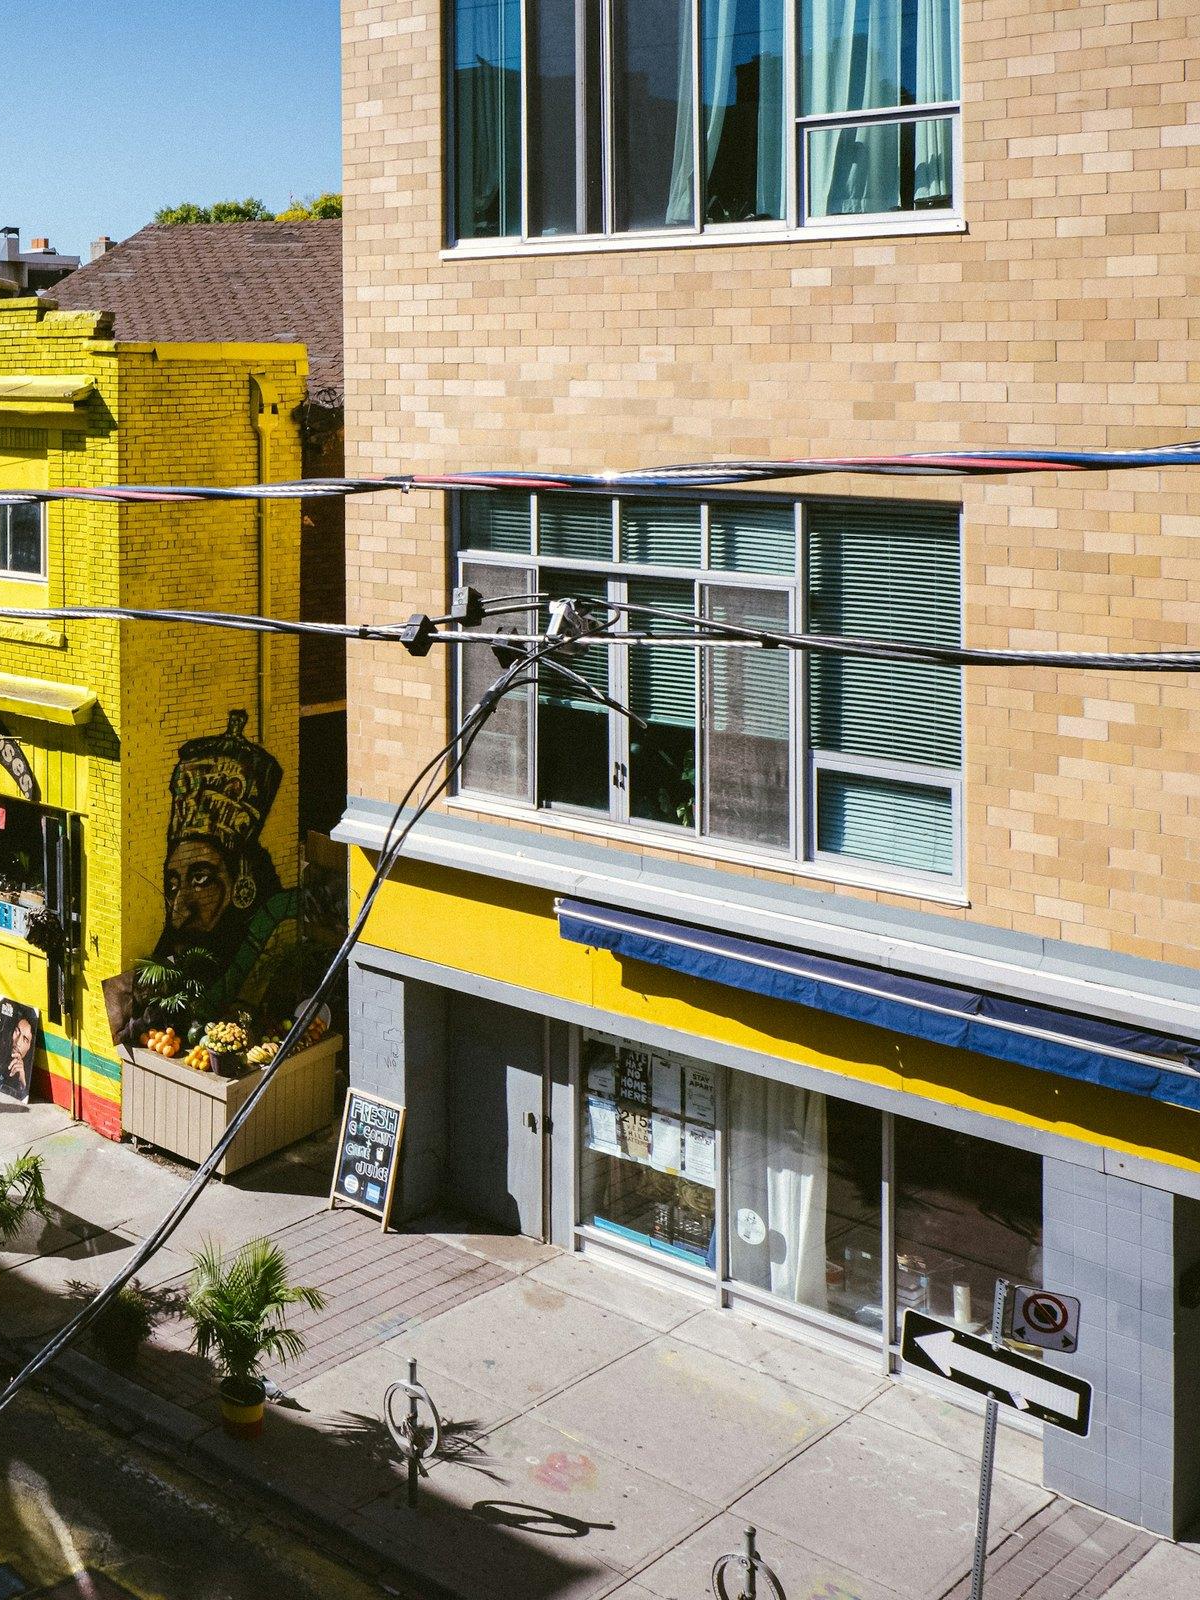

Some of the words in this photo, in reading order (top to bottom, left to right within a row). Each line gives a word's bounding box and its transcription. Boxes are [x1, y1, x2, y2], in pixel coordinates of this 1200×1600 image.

[626, 1059, 643, 1072] HAS
[627, 1068, 641, 1080] NO
[621, 1076, 647, 1093] HOME
[689, 1080, 714, 1092] APART
[692, 1072, 710, 1084] STAY
[620, 1087, 647, 1104] HERE
[350, 1097, 398, 1133] FRESH
[620, 1110, 648, 1128] 215
[345, 1142, 371, 1160] CANE
[355, 1160, 389, 1182] JUICE
